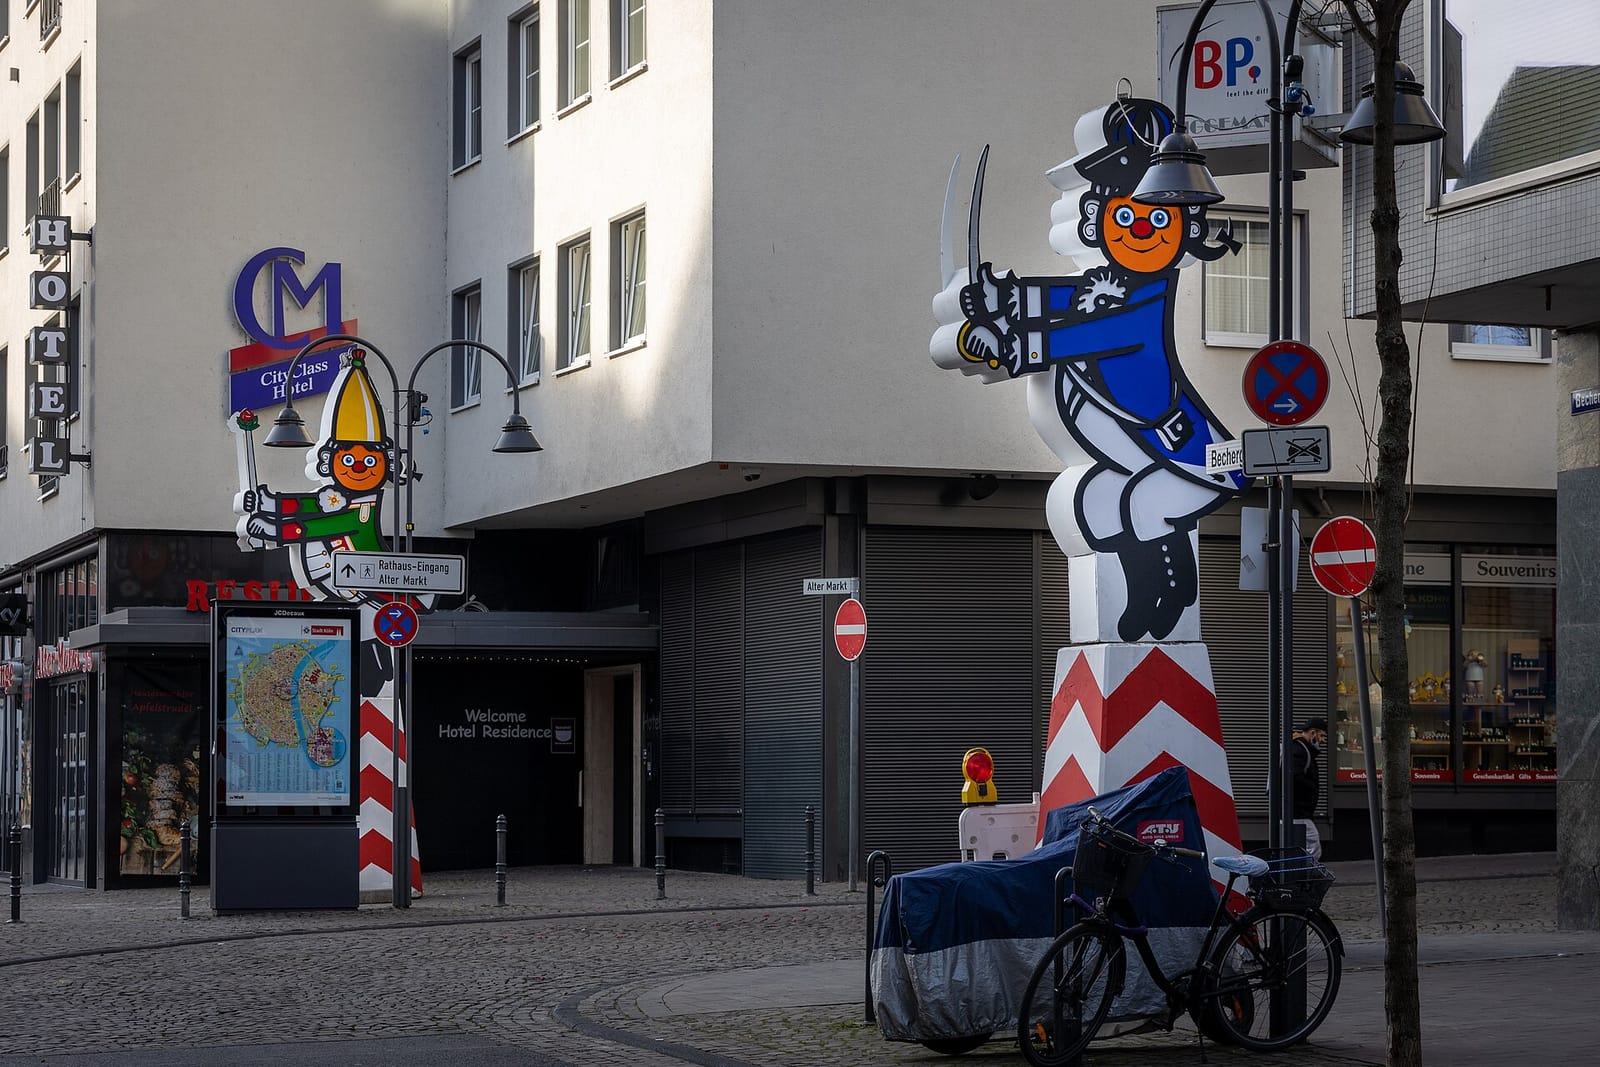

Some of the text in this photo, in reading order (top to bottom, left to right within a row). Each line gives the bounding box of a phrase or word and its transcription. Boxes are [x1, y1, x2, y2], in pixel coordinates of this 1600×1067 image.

[1226, 90, 1240, 98] feel
[37, 219, 68, 470] HOTEL
[1211, 447, 1243, 468] Becherg
[378, 559, 450, 575] Rathaus-Eingang
[1476, 560, 1557, 578] Souvenirs
[378, 574, 428, 586] Alter Markt
[807, 581, 848, 591] Alter Markt
[273, 609, 305, 617] JCDecaux
[464, 708, 527, 723] Welcome
[438, 724, 552, 739] Hotel Residence
